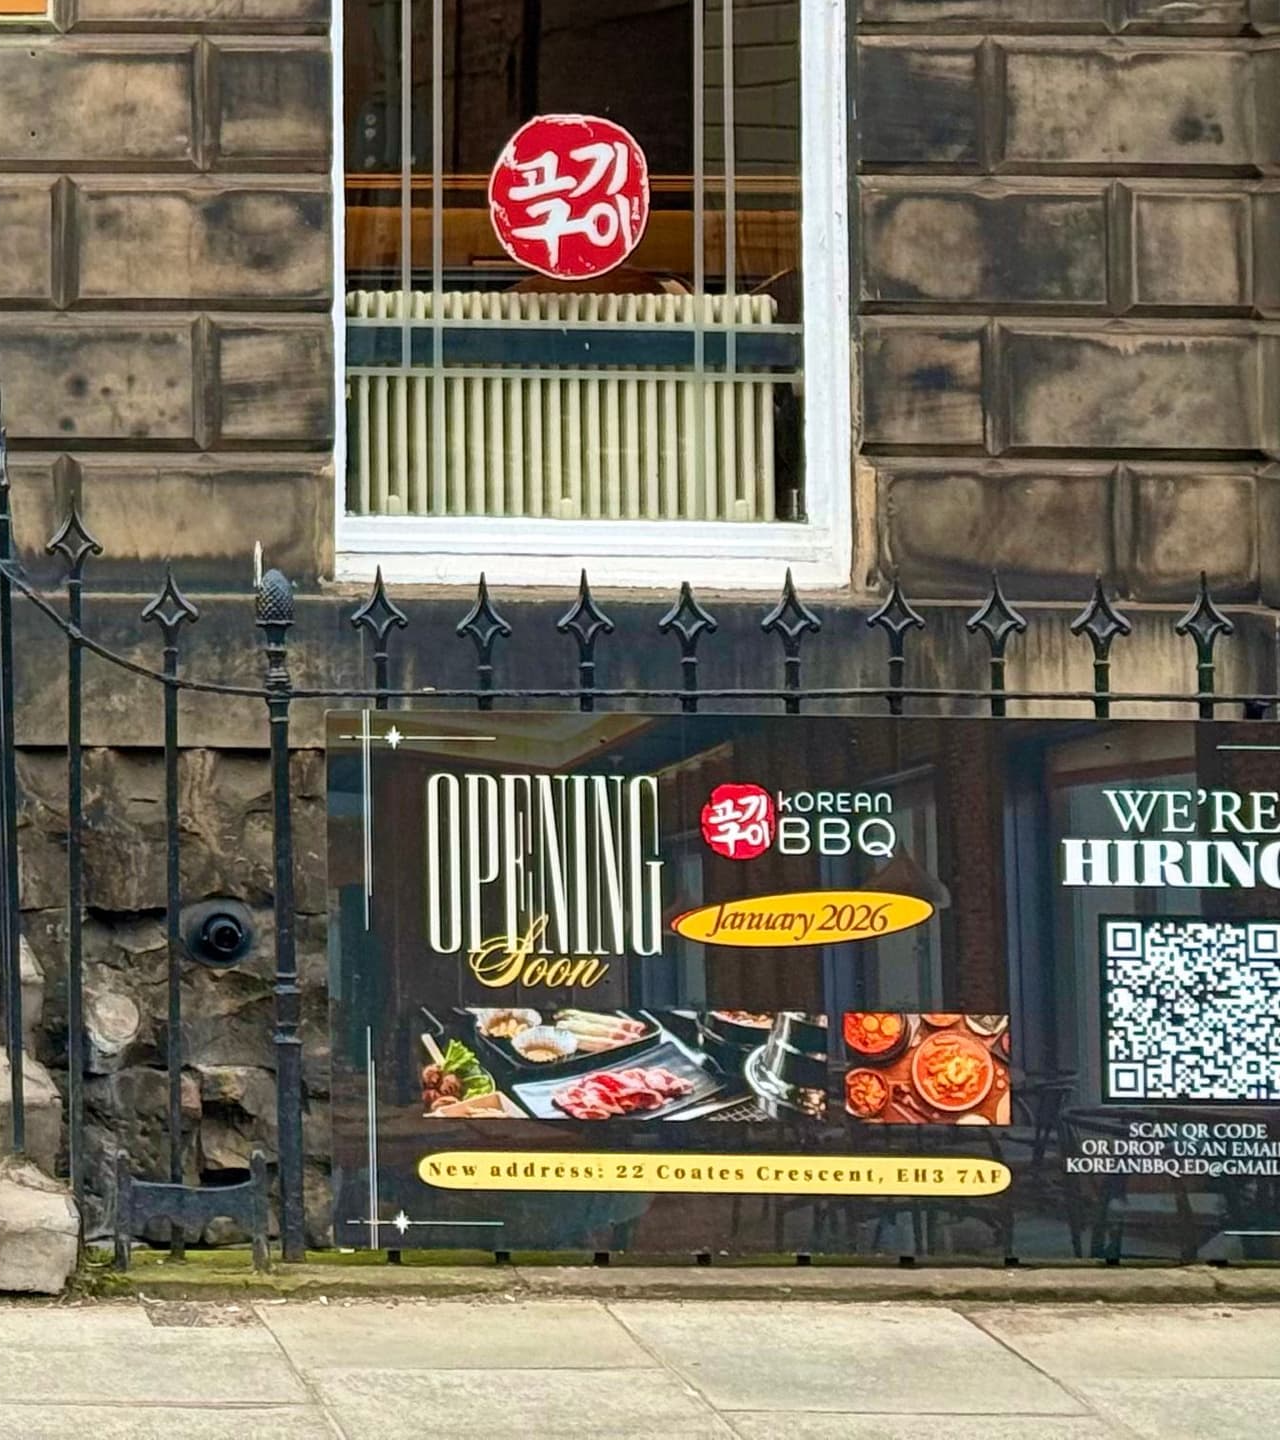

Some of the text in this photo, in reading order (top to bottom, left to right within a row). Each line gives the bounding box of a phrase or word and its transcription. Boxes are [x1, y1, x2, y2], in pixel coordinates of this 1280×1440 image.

[507, 141, 629, 201] 고기
[511, 194, 633, 268] 구이
[709, 794, 768, 823] 고기
[709, 820, 772, 857] 구이
[777, 818, 897, 858] BBQ
[427, 772, 666, 957] OPENING
[706, 902, 889, 942] January 2026
[469, 912, 611, 989] Soon
[1081, 1140, 1280, 1157] OR DROP US AN EMAI
[1128, 1122, 1269, 1141] SCAN QR CODE
[429, 1161, 477, 1177] New
[489, 1162, 606, 1179] address:
[615, 1164, 645, 1179] 22
[656, 1164, 746, 1181] Coates
[756, 1166, 886, 1185] Crescent,
[896, 1167, 945, 1183] EH3
